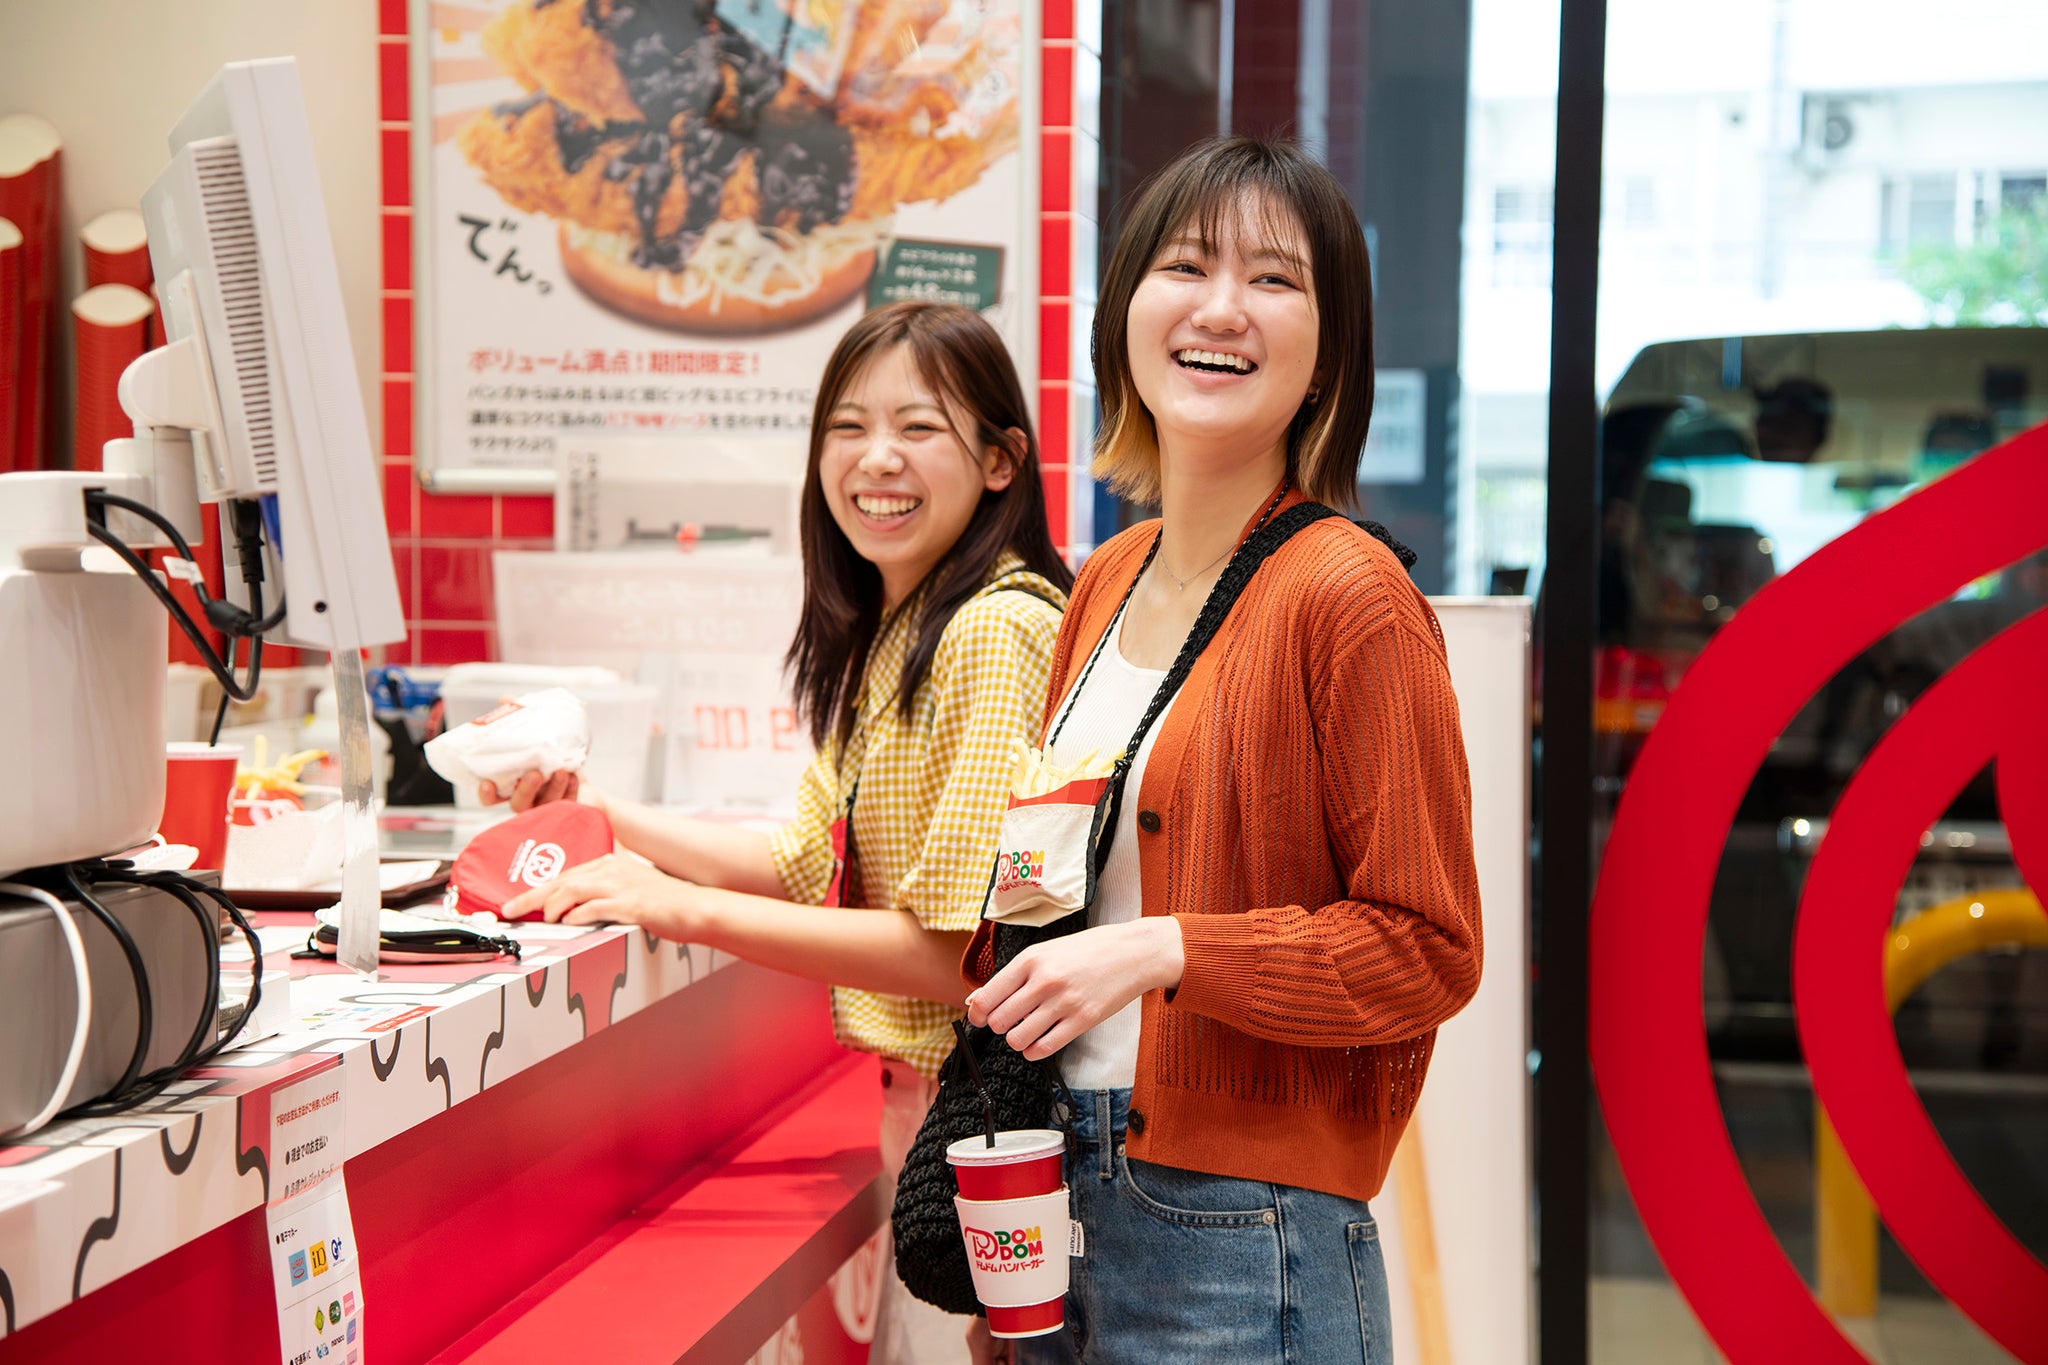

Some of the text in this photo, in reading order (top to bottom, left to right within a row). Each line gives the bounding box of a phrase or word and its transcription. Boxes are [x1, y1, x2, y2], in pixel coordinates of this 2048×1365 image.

[1012, 850, 1045, 865] DOM
[1011, 864, 1043, 880] DOM
[994, 1225, 1042, 1246] DOM
[999, 1240, 1044, 1261] DOM
[975, 1258, 1046, 1273] ドムドムハンバーガー
